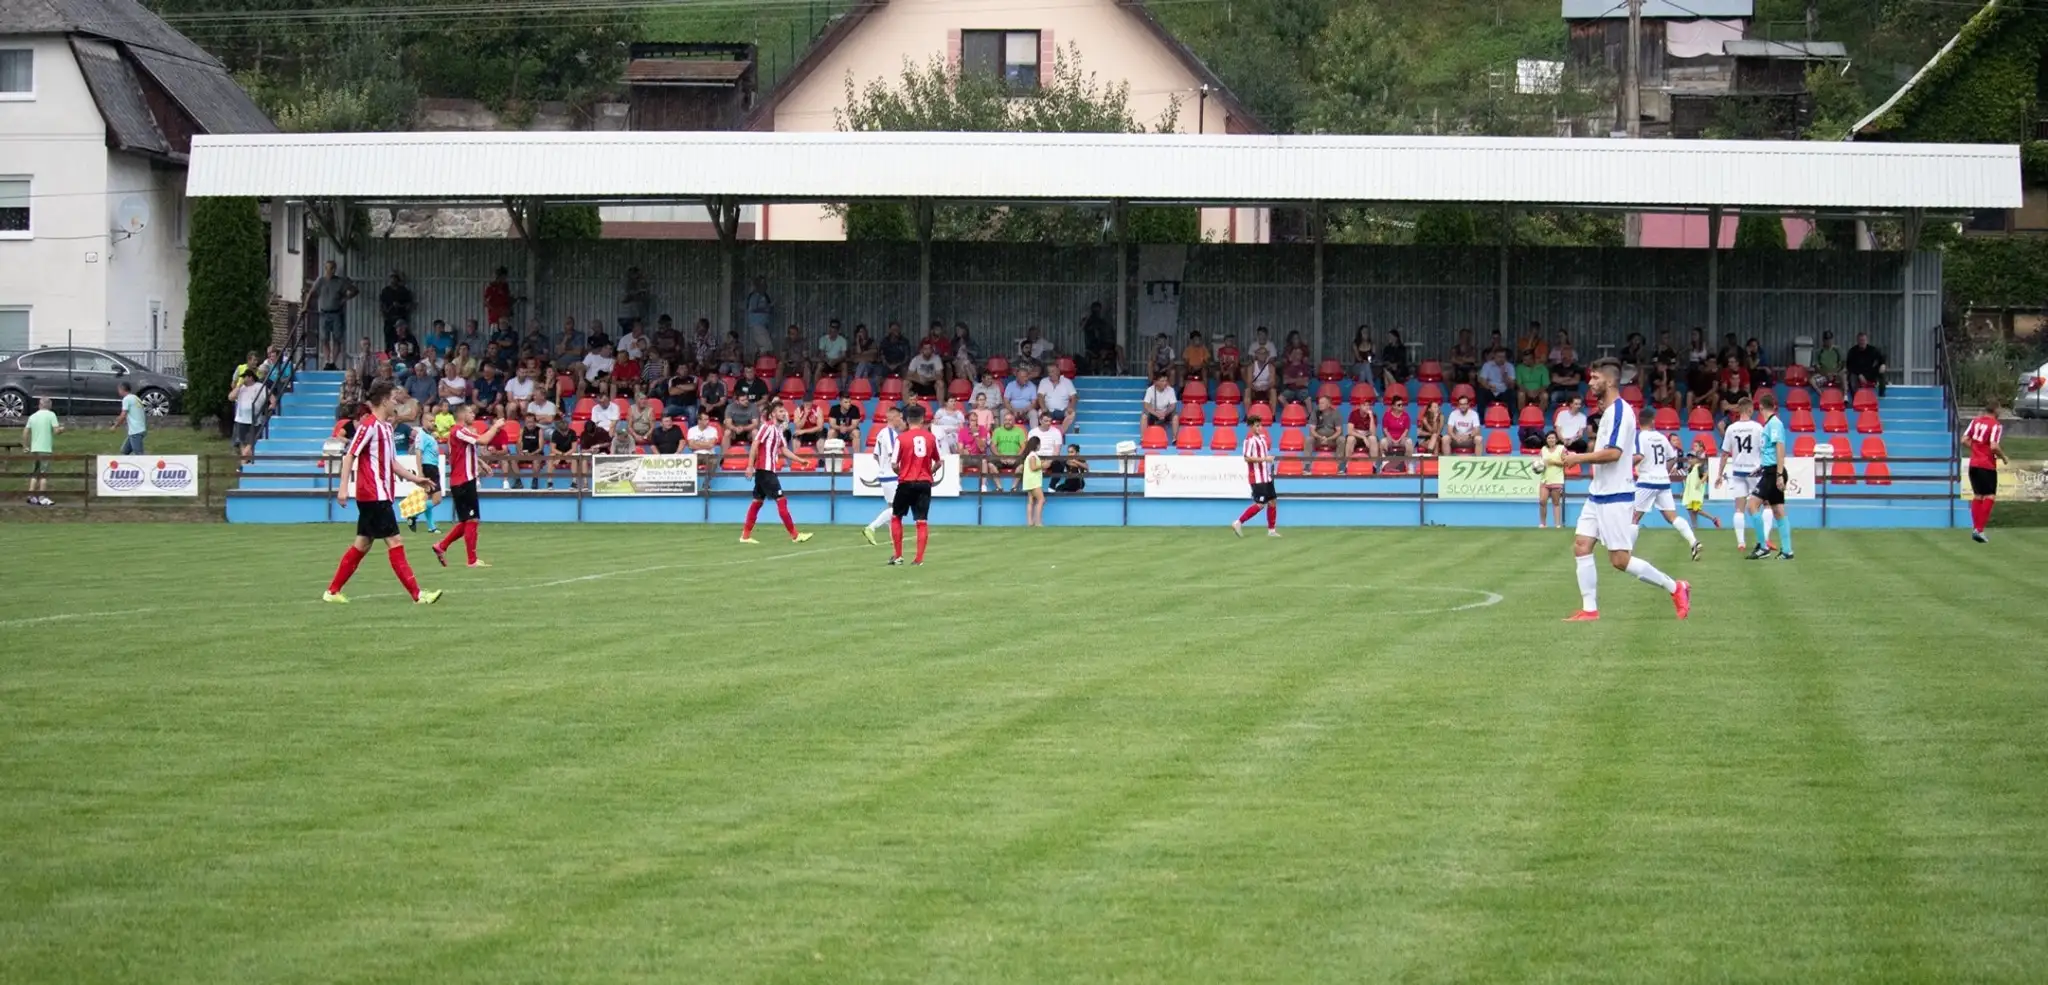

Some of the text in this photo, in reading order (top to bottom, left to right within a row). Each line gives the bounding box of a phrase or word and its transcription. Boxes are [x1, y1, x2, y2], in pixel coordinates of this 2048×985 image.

[1972, 422, 1988, 442] 17
[913, 436, 927, 458] 8
[1734, 434, 1753, 454] 14
[642, 458, 692, 468] MIDOPO
[1651, 444, 1665, 465] 13
[1448, 460, 1533, 480] STYLEX
